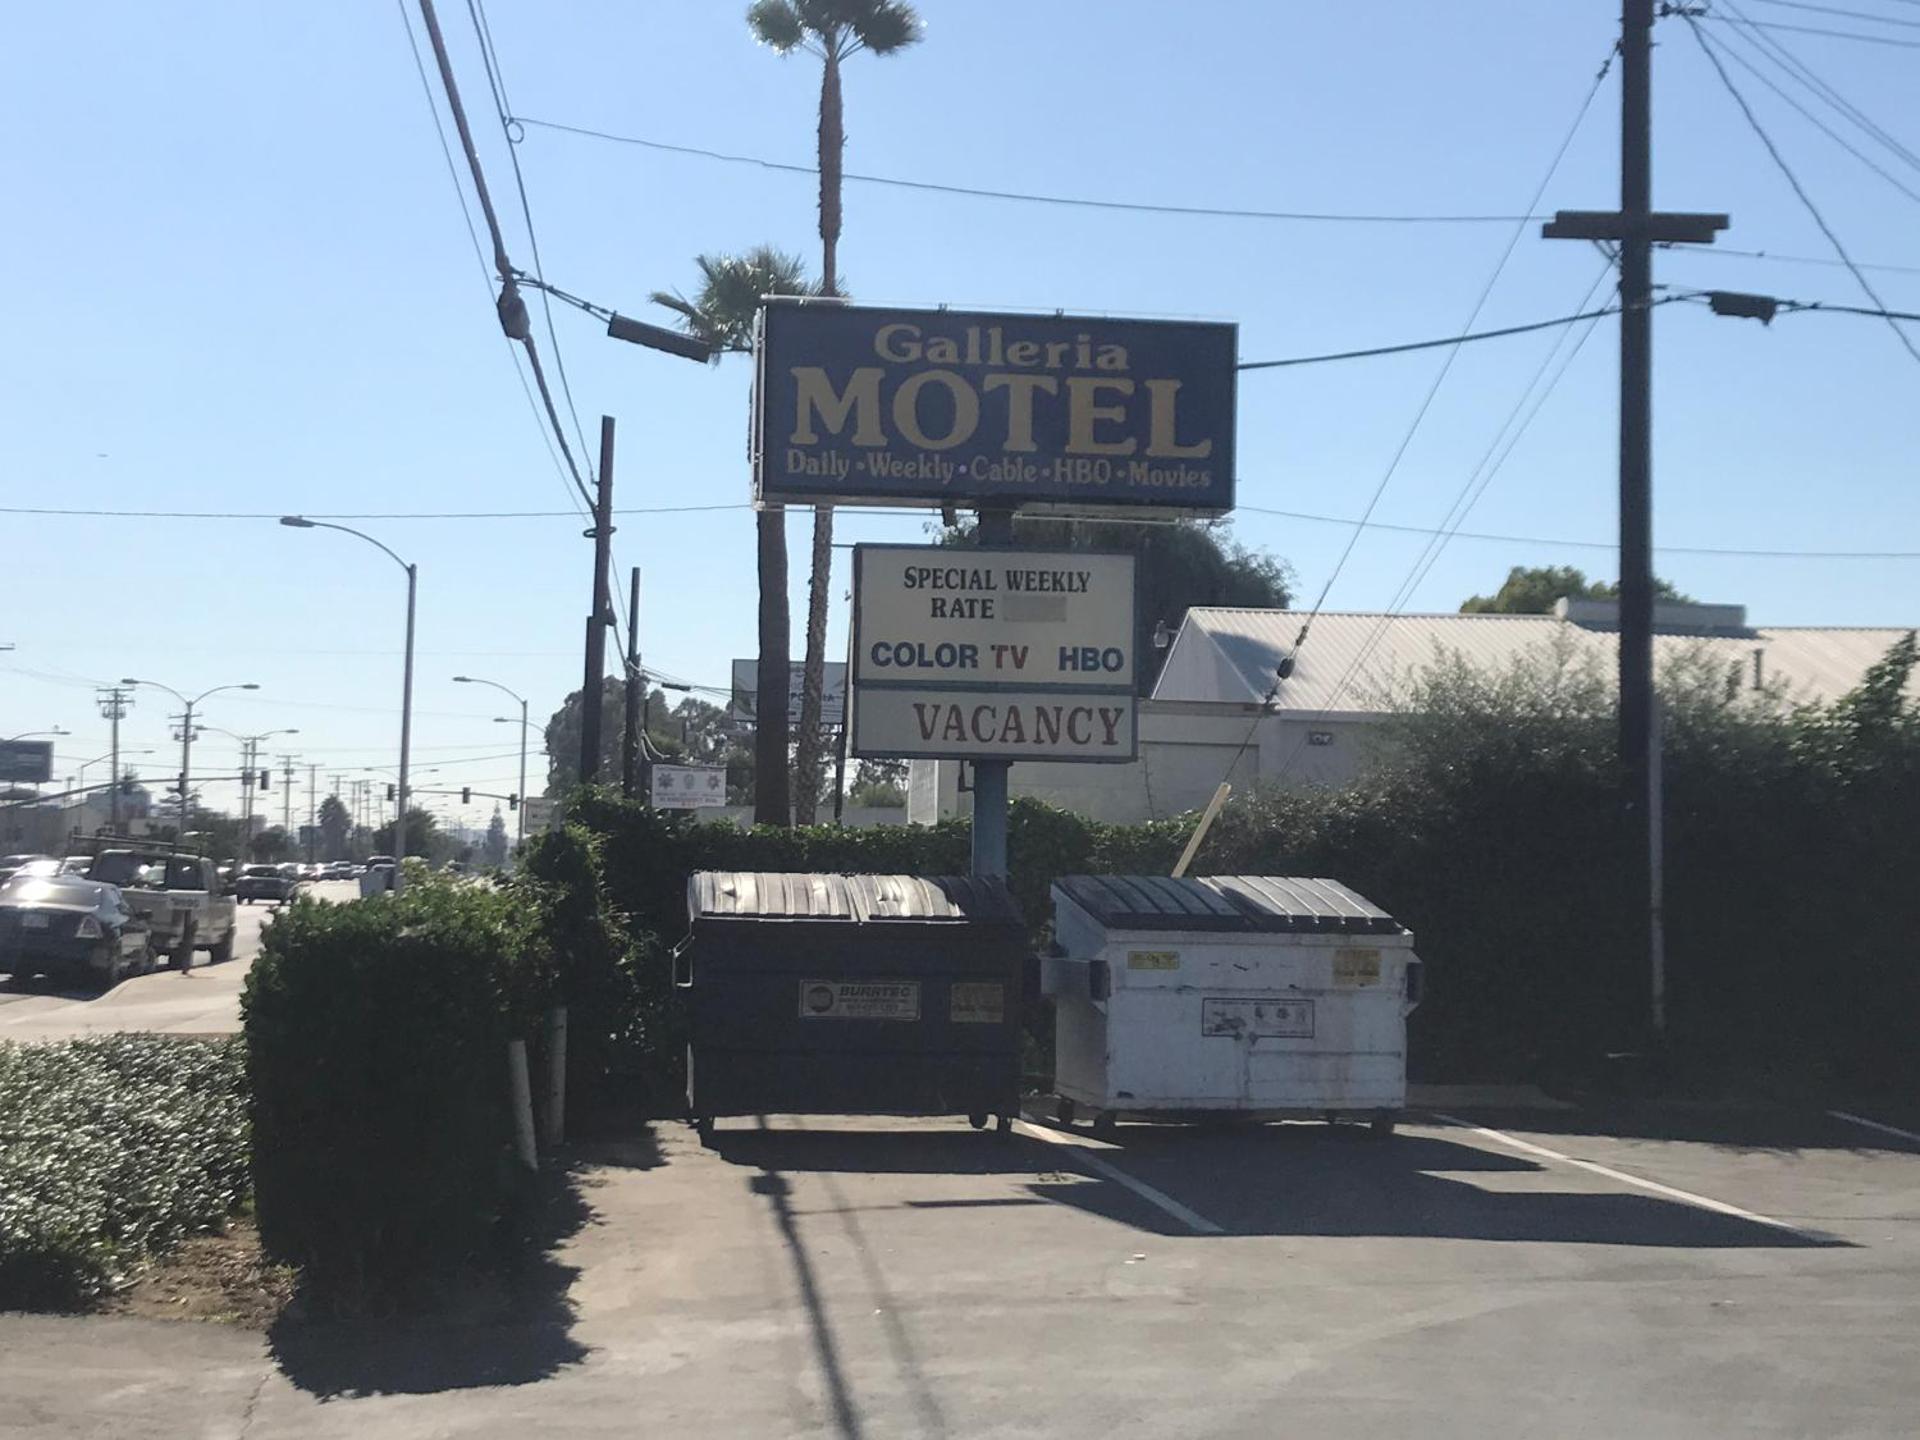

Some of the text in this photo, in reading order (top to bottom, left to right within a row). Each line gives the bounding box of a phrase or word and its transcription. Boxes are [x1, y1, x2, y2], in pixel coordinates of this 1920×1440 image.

[875, 323, 1129, 370] Galleria
[790, 366, 1213, 458] MOTEL
[786, 448, 1213, 489] Daily Weekly Cable HBO Movies
[903, 566, 1091, 593] SPECIAL WEEKLY
[930, 597, 994, 620] RATE
[871, 641, 1124, 673] COLOR TV HBO
[913, 703, 1125, 746] VACANCY
